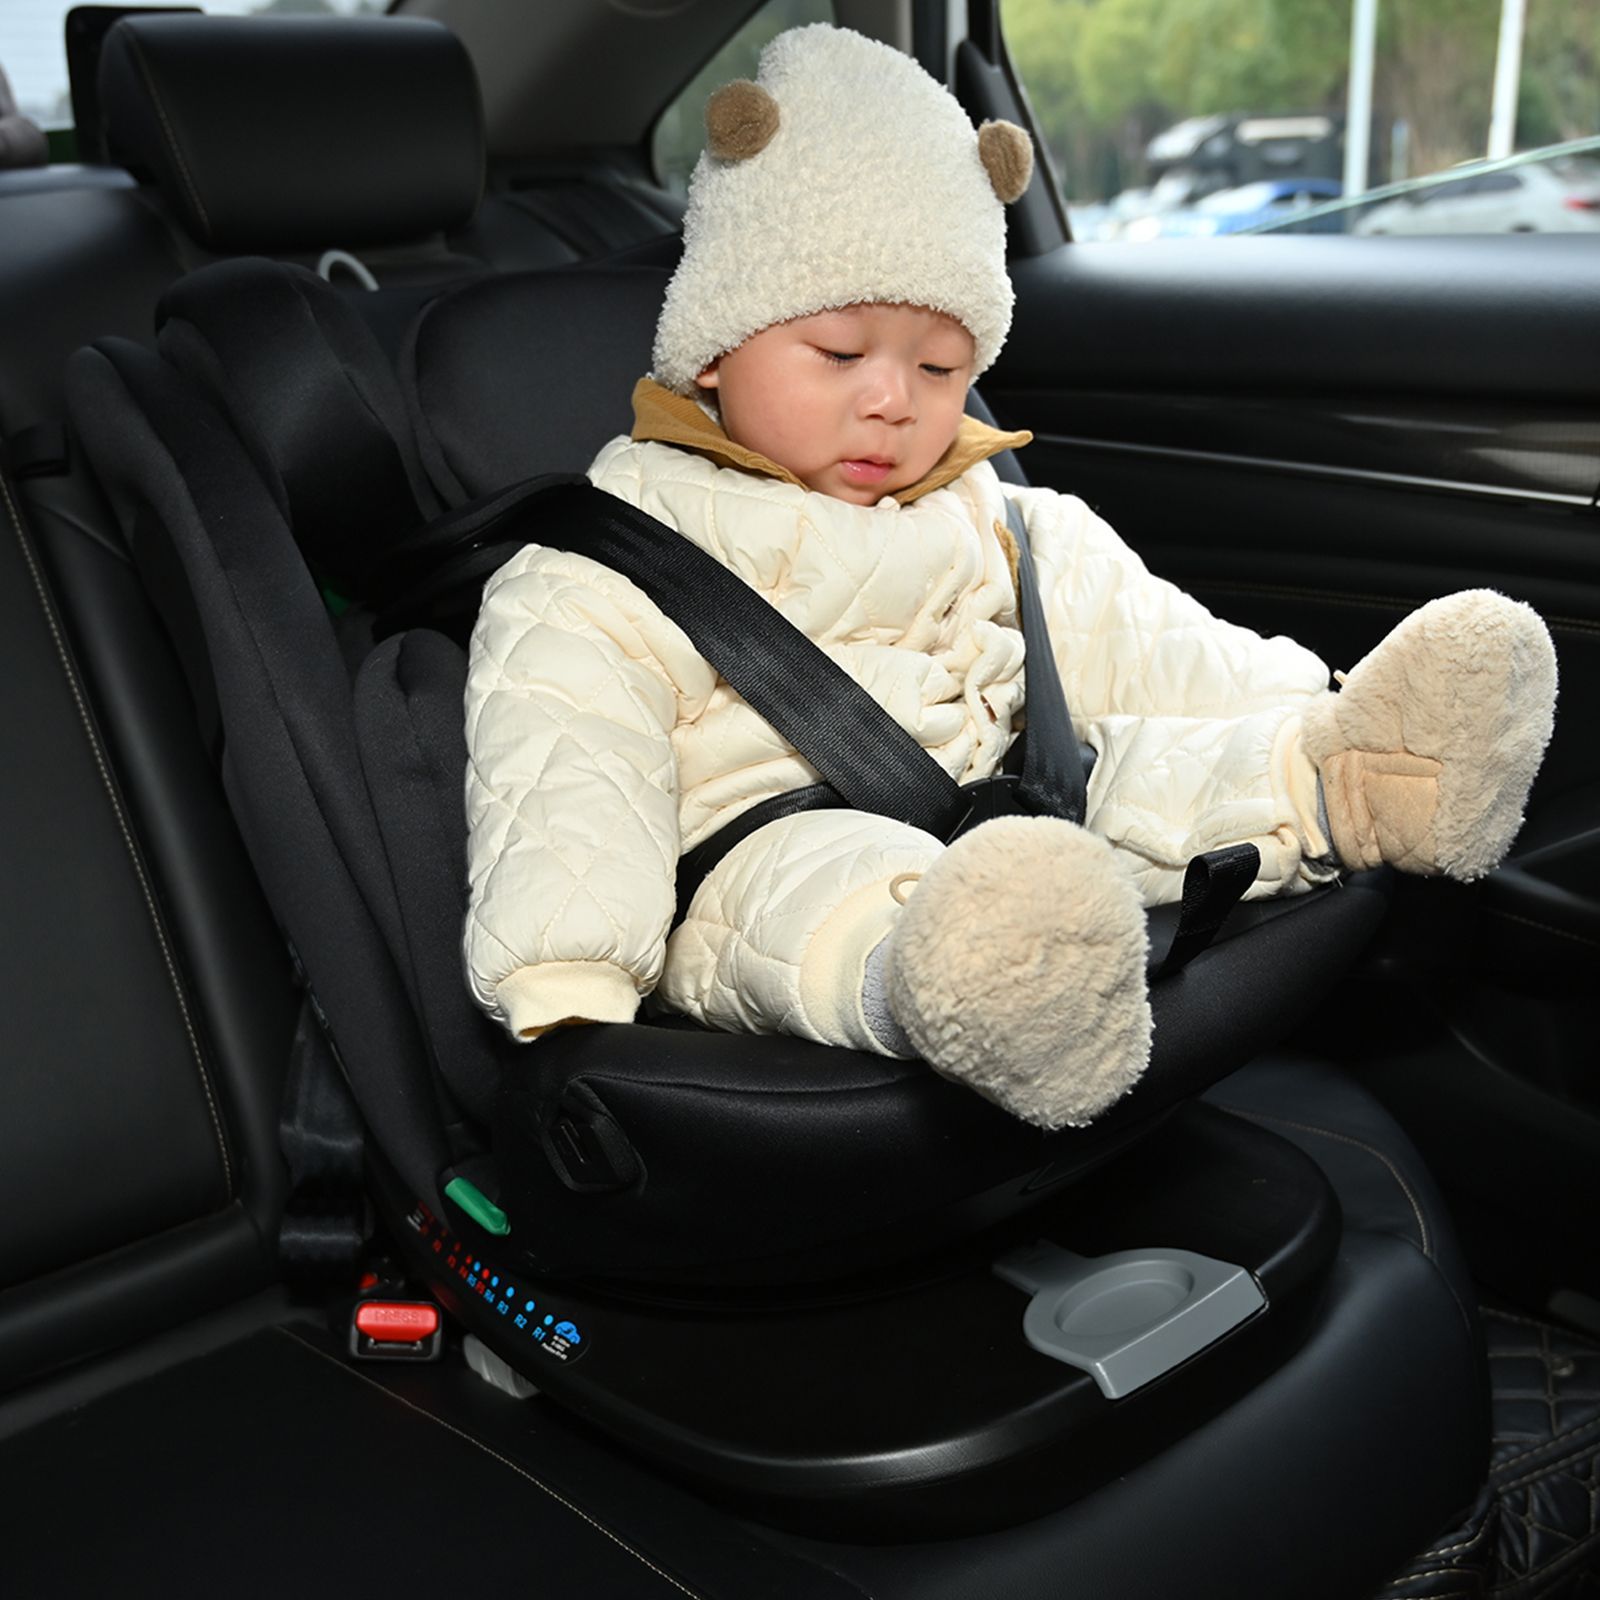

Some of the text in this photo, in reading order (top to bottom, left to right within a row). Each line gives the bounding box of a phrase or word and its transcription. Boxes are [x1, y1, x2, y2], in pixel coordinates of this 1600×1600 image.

[483, 1288, 496, 1303] R4
[496, 1300, 509, 1315] R3
[513, 1313, 528, 1329] R2
[532, 1326, 546, 1342] R1
